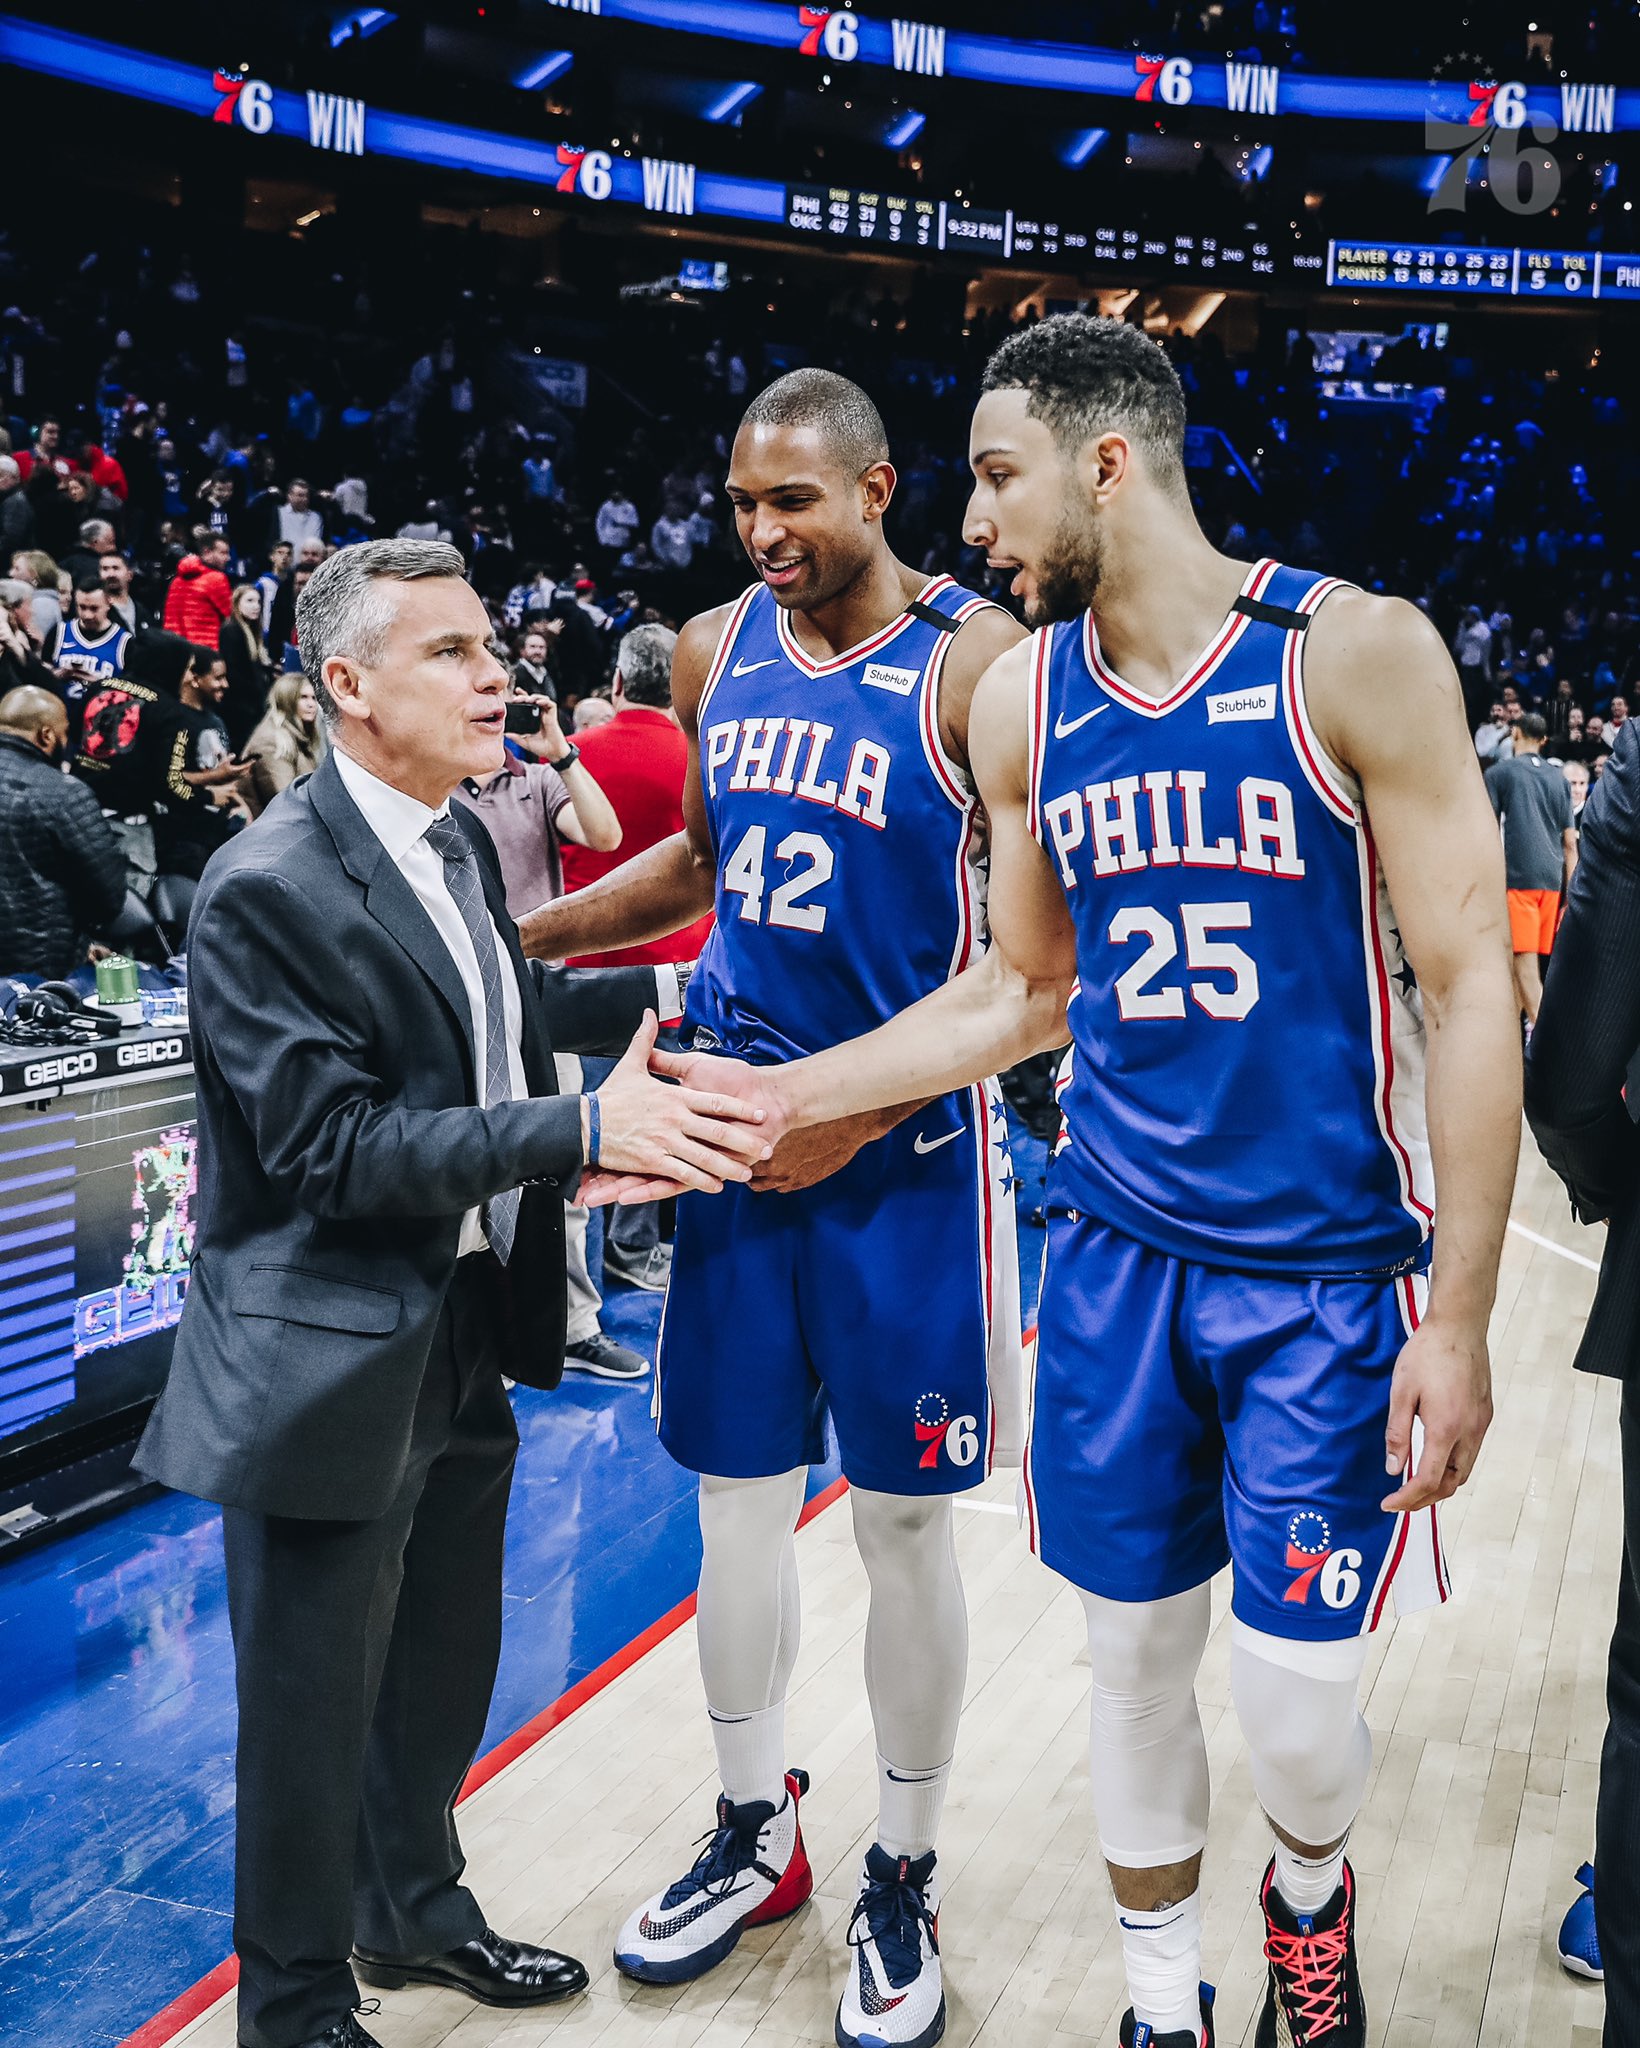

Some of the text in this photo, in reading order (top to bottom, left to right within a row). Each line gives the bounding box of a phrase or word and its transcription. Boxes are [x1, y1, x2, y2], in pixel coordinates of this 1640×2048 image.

[799, 5, 946, 77] 76 WIN
[1135, 54, 1279, 115] 76 WIN
[213, 70, 365, 156] 76 WIN
[1468, 80, 1616, 133] 76 WIN
[556, 144, 696, 216] 76 WIN
[789, 212, 929, 245] OKC 47 17 3 3
[792, 194, 930, 230] PHI 42 31 0 4
[947, 218, 1003, 240] 9:32 PM
[1014, 237, 1034, 251] NO
[1142, 240, 1168, 255] 2ND
[1221, 247, 1245, 262] 2ND
[1337, 247, 1509, 270] PLAYER 42 21 0 25 23
[1527, 252, 1588, 271] FLS TOL
[1337, 264, 1388, 282] POINTS
[1439, 269, 1460, 285] 23
[1465, 270, 1482, 287] 17
[1489, 271, 1507, 288] 12
[1529, 269, 1582, 292] 5 0
[869, 669, 909, 687] StubHub
[1216, 697, 1267, 714] StubHub
[706, 717, 892, 832] PHILA
[1042, 769, 1306, 891] PHILA
[723, 824, 835, 934] 42
[1107, 901, 1261, 1022] 25
[24, 1051, 98, 1087] GEICO
[116, 1038, 183, 1067] GEICO
[914, 1415, 980, 1469] 76
[1283, 1541, 1363, 1610] 76
